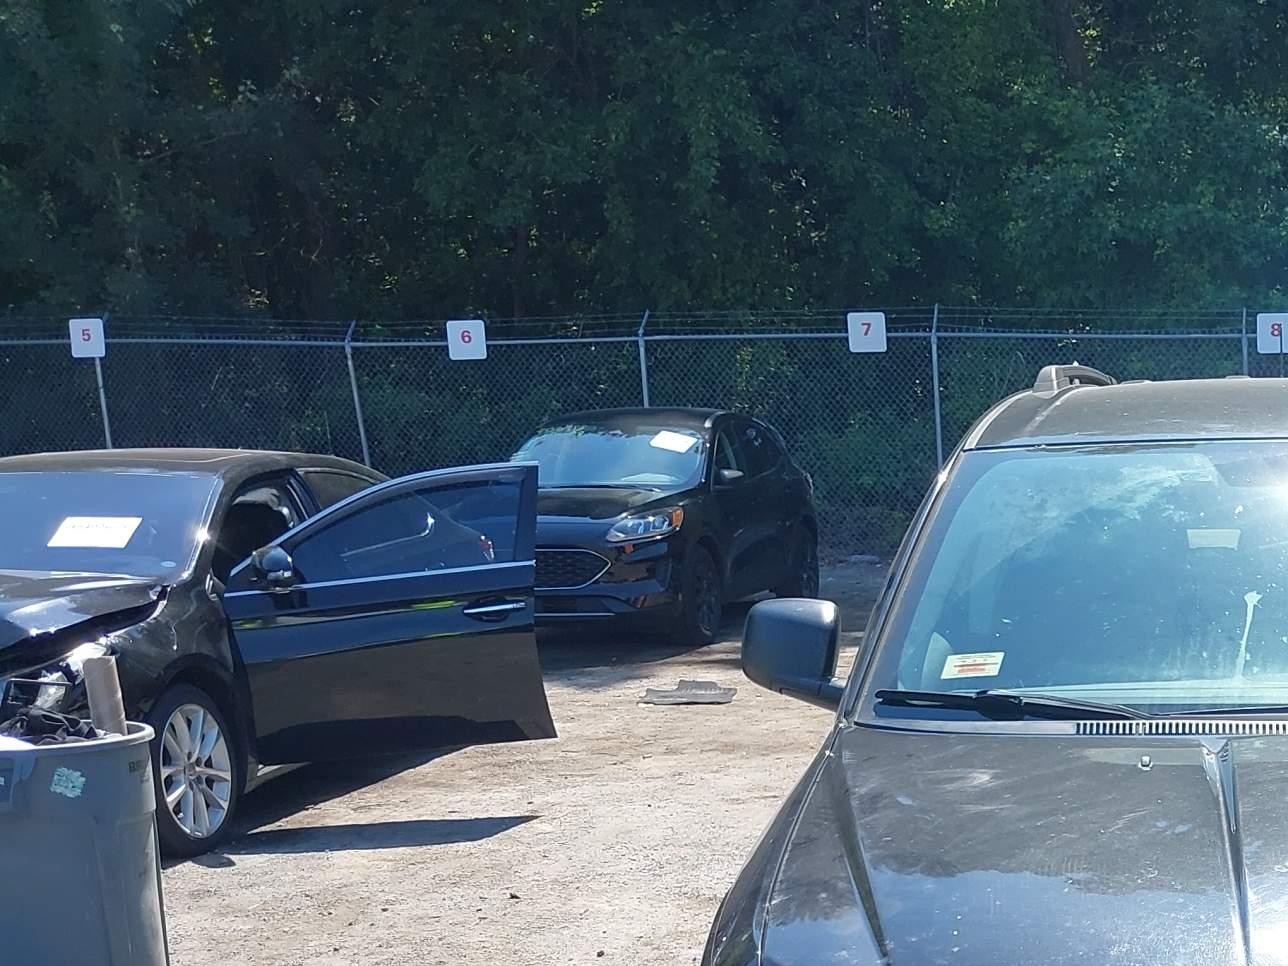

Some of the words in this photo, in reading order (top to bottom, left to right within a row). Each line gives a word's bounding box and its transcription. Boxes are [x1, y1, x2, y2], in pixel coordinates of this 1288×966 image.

[81, 328, 92, 342] 5
[861, 322, 872, 337] 7
[1270, 323, 1281, 337] 8
[460, 330, 472, 344] 6
